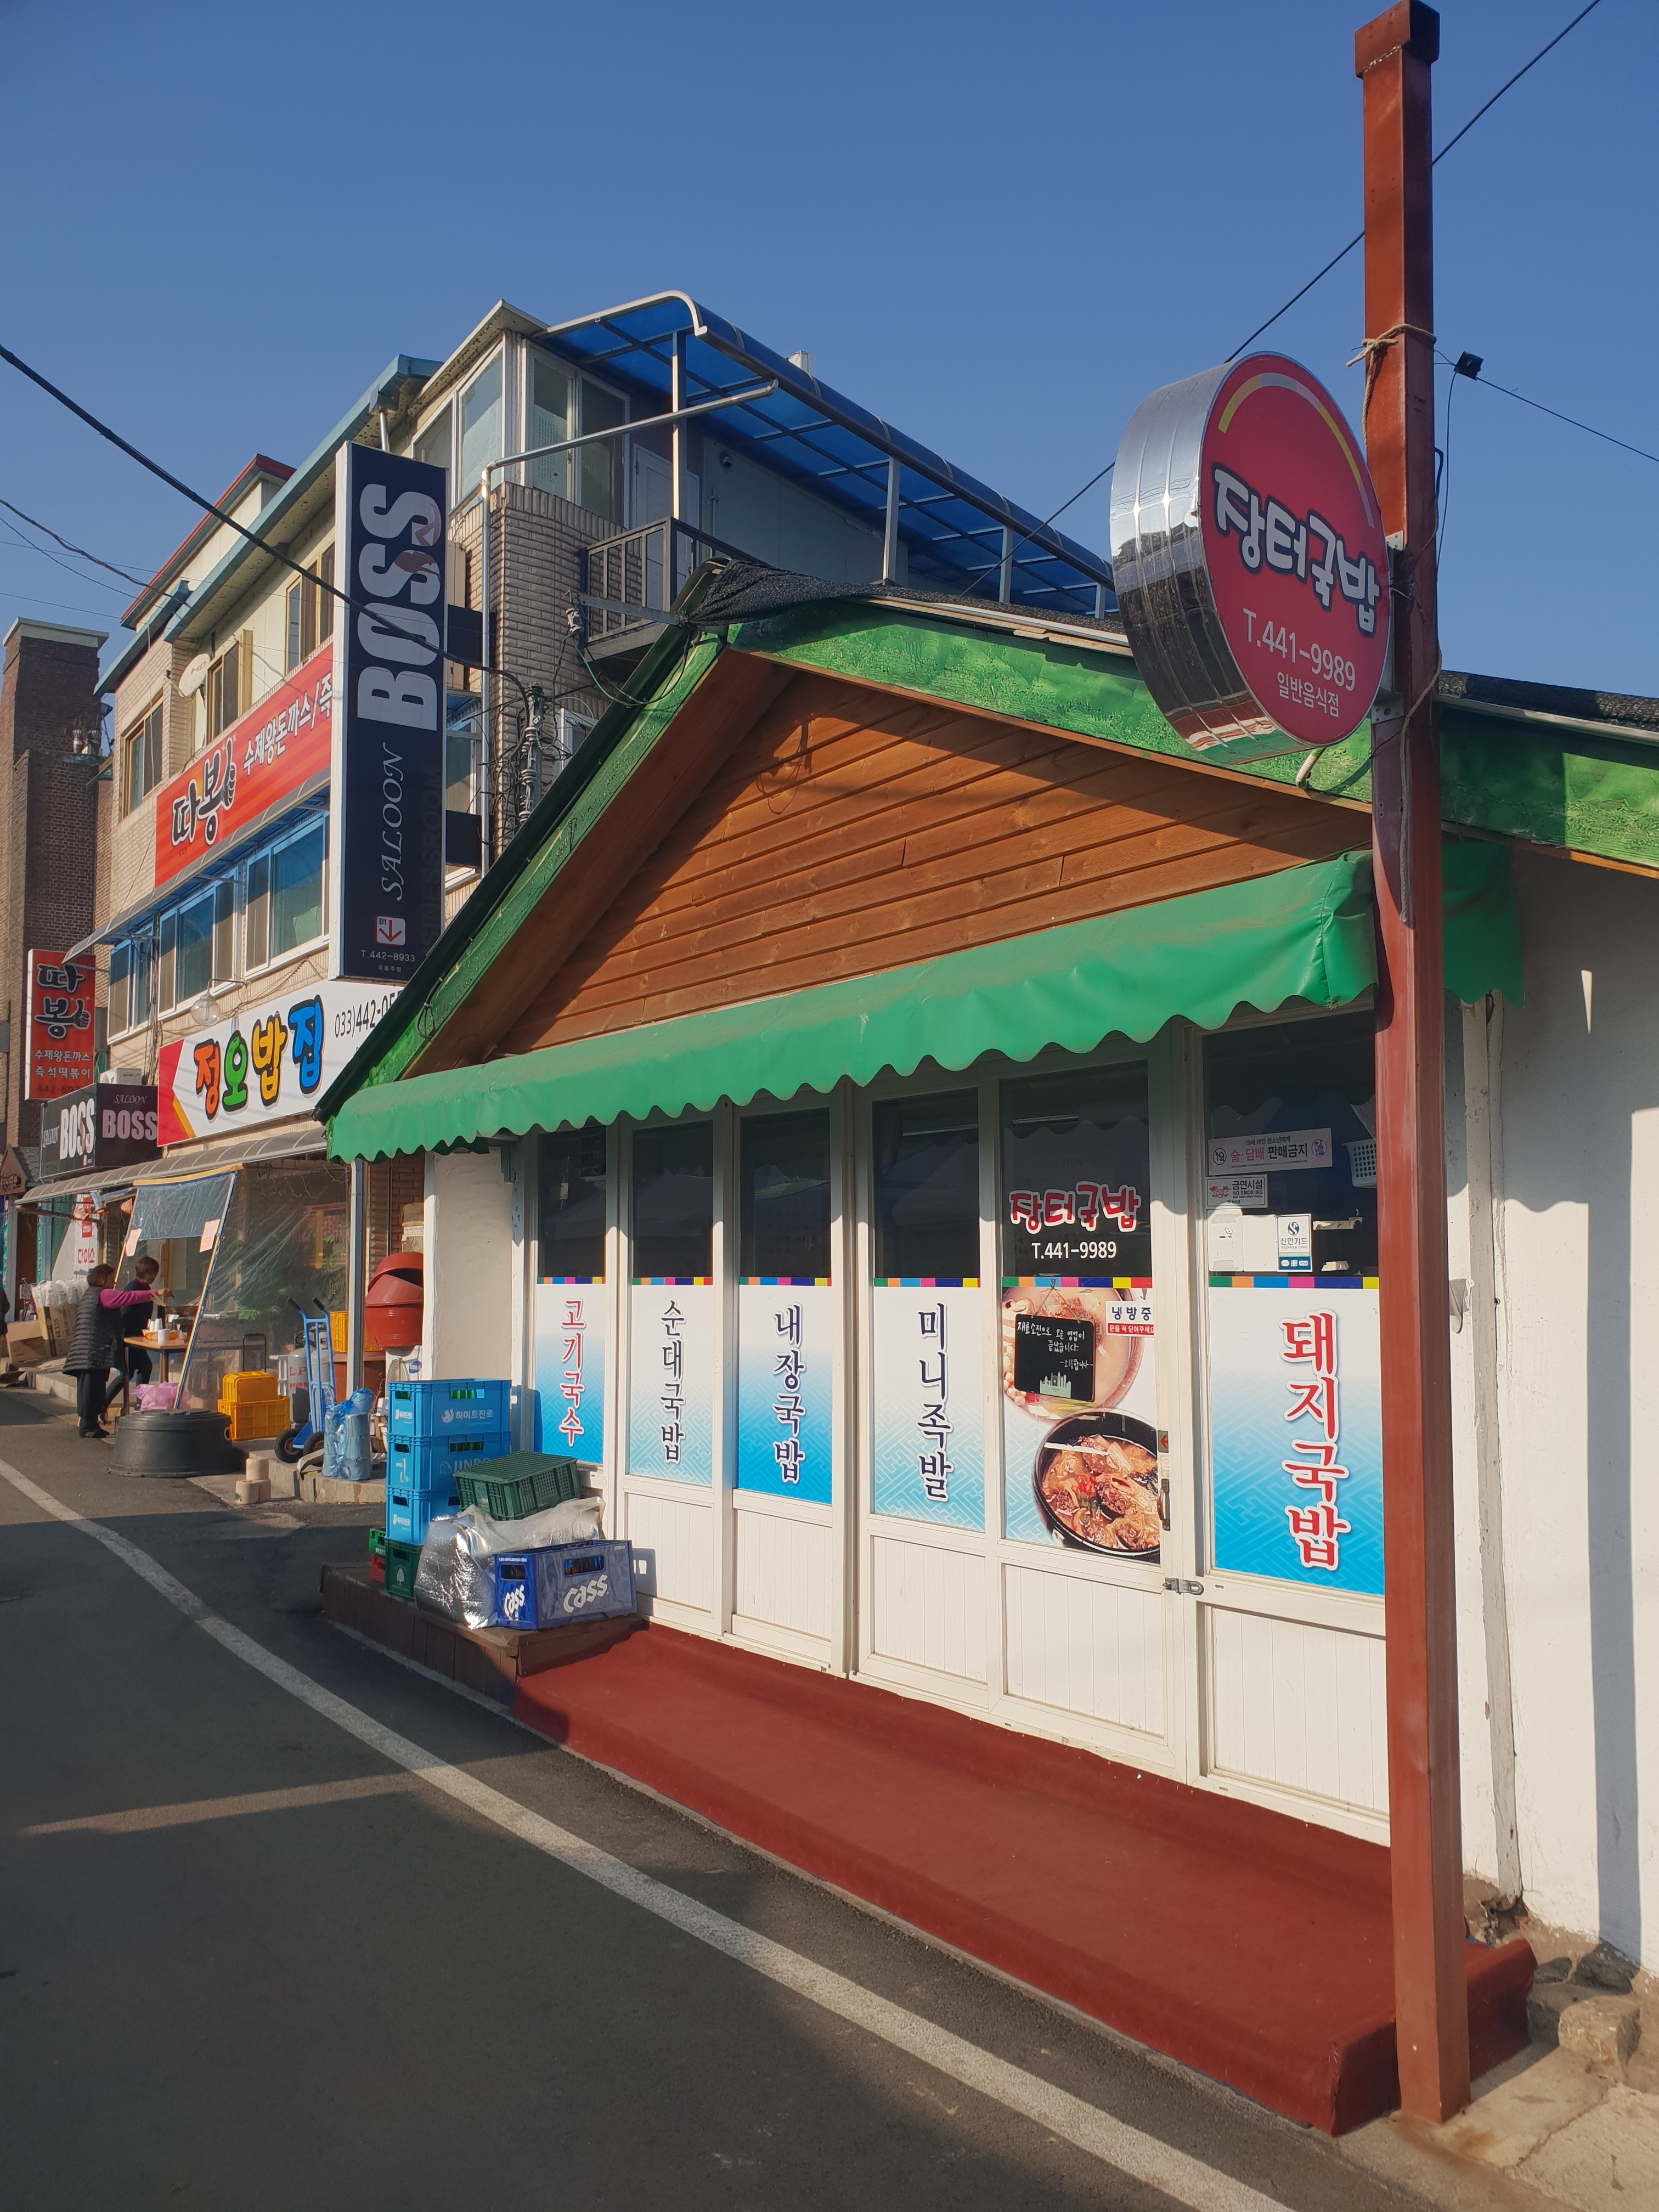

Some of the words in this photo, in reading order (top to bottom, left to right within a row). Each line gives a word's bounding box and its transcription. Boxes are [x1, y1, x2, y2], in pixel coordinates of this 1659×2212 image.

[1214, 466, 1380, 634] 장터국밥
[357, 484, 442, 731] BOSS
[190, 661, 206, 675] HD
[1243, 608, 1355, 691] T.441-9989
[1277, 672, 1339, 718] 일반음식점
[172, 737, 236, 845] 따봉
[381, 742, 404, 902] SALOON
[379, 917, 387, 926] B1
[360, 950, 415, 962] T.442-8933
[35, 963, 91, 1039] 따봉
[335, 990, 404, 1038] 033)442-05
[35, 1049, 91, 1063] 수제왕돈까스
[35, 1065, 91, 1079] 즉석떡볶이
[194, 995, 325, 1120] 정오밥집
[114, 1094, 147, 1104] SALOON
[60, 1098, 95, 1160] BOSS
[102, 1109, 157, 1141] BOSS
[1231, 1147, 1265, 1163] 술·담배
[1267, 1143, 1308, 1160] 판매금지
[1232, 1179, 1263, 1190] 금연시설
[1010, 1182, 1140, 1233] 장터국밥
[77, 1248, 95, 1264] 다이소
[1031, 1241, 1117, 1259] T.441-9989
[1280, 1237, 1308, 1245] 신한카드
[1017, 1321, 1052, 1336] 재료소진으로
[1056, 1329, 1064, 1340] 오늘
[1067, 1330, 1085, 1342] 영업이
[1111, 1306, 1152, 1321] 냉방중
[560, 1300, 585, 1445] 고기국수
[660, 1300, 685, 1462] 순대국밥
[772, 1304, 805, 1482] 내장국밥
[917, 1302, 952, 1499] 미니족발
[455, 1409, 493, 1420] 하이트진로
[1282, 1312, 1348, 1567] 돼지국밥
[504, 1584, 526, 1617] Cass
[563, 1575, 608, 1613] Cass
